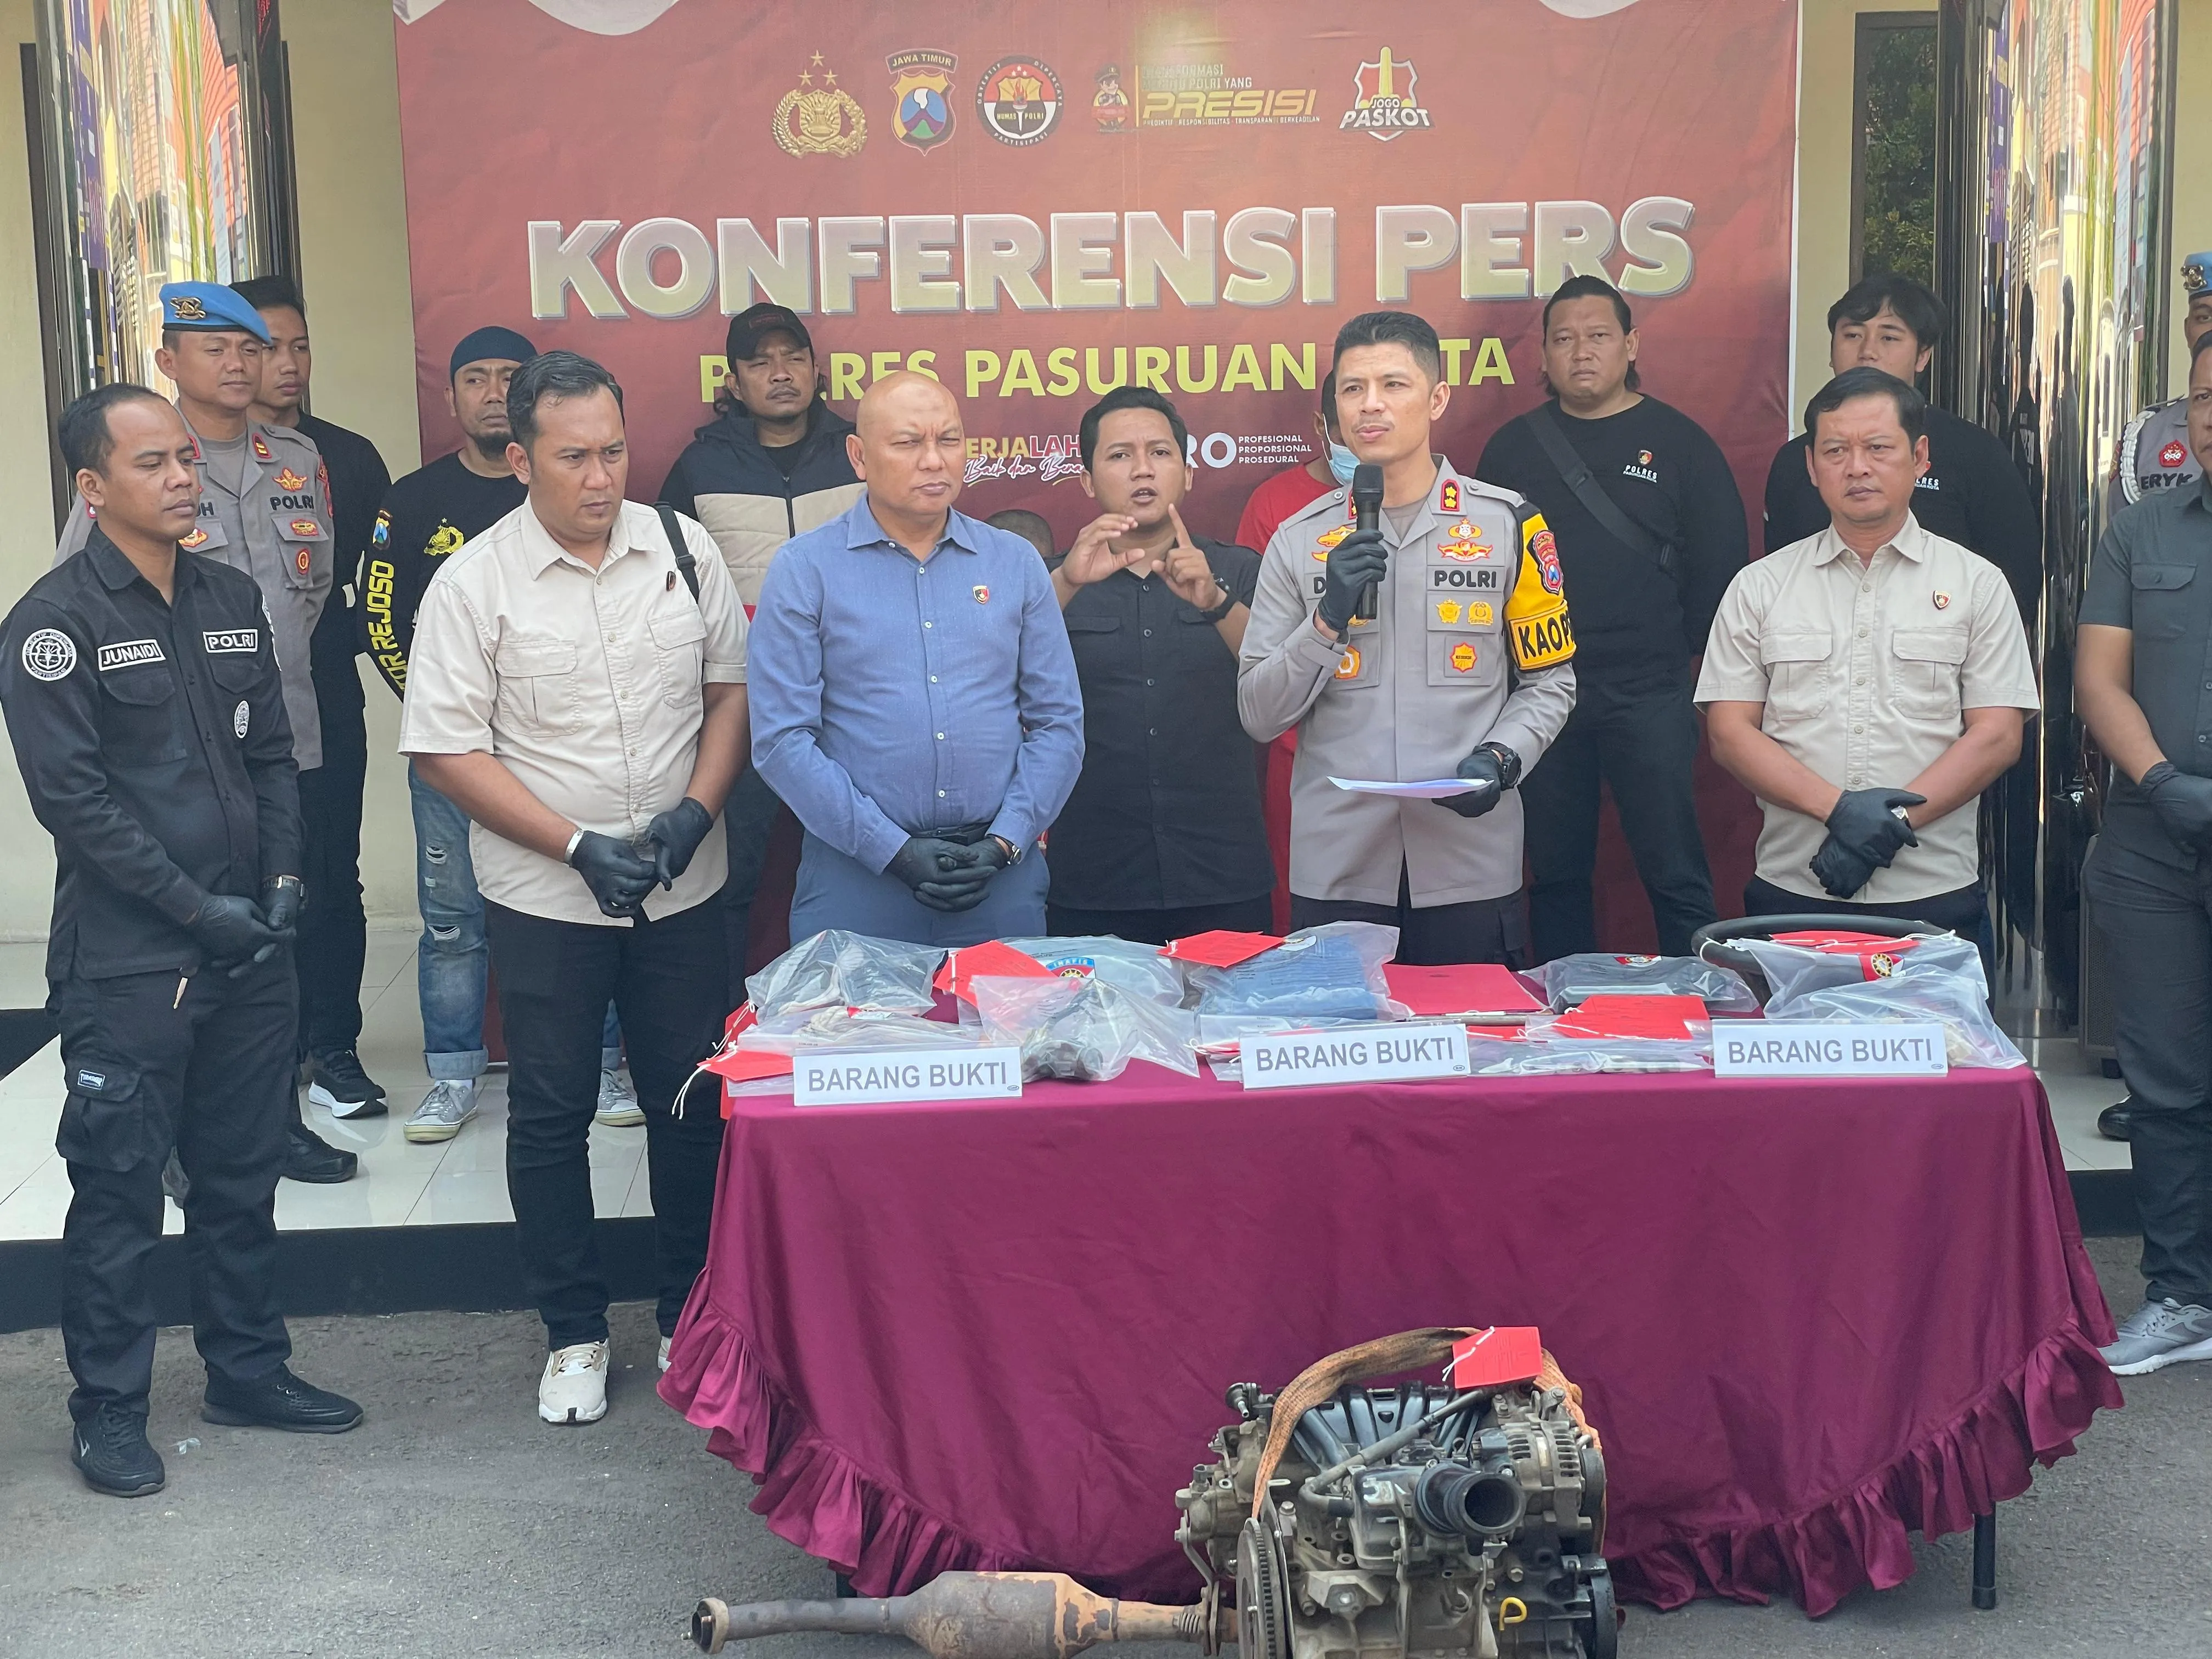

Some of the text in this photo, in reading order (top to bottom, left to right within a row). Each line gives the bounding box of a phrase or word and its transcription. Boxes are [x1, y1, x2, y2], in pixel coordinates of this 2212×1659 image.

[893, 54, 952, 66] JAWA TIMUR
[1224, 76, 1252, 88] YANG
[1142, 89, 1317, 119] PRESISI
[1372, 99, 1400, 109] JOGO
[1339, 108, 1430, 129] PASKOT
[527, 196, 1695, 318] KONFERENSI PERS
[700, 337, 1515, 403] PRES PASURUAN TA
[966, 435, 1081, 459] ERJALAH
[1239, 435, 1302, 443] PROFESIONAL
[1239, 444, 1312, 453] PROPORSIONAL
[1186, 432, 1237, 469] RO
[1239, 455, 1299, 464] PROSEDURAL
[1039, 455, 1085, 481] Bena
[1625, 465, 1657, 479] POLRES
[1916, 477, 1939, 486] LRES
[270, 495, 314, 510] POLRI
[1434, 570, 1497, 588] POLRI
[367, 560, 398, 650] REJOSO
[208, 634, 254, 650] POLRI
[103, 644, 160, 665] JUNAIDI
[1256, 1037, 1454, 1071] BARANG BUKTI
[1728, 1039, 1932, 1064] BARANG BUKTI
[808, 1062, 1006, 1092] BARANG BUKTI
